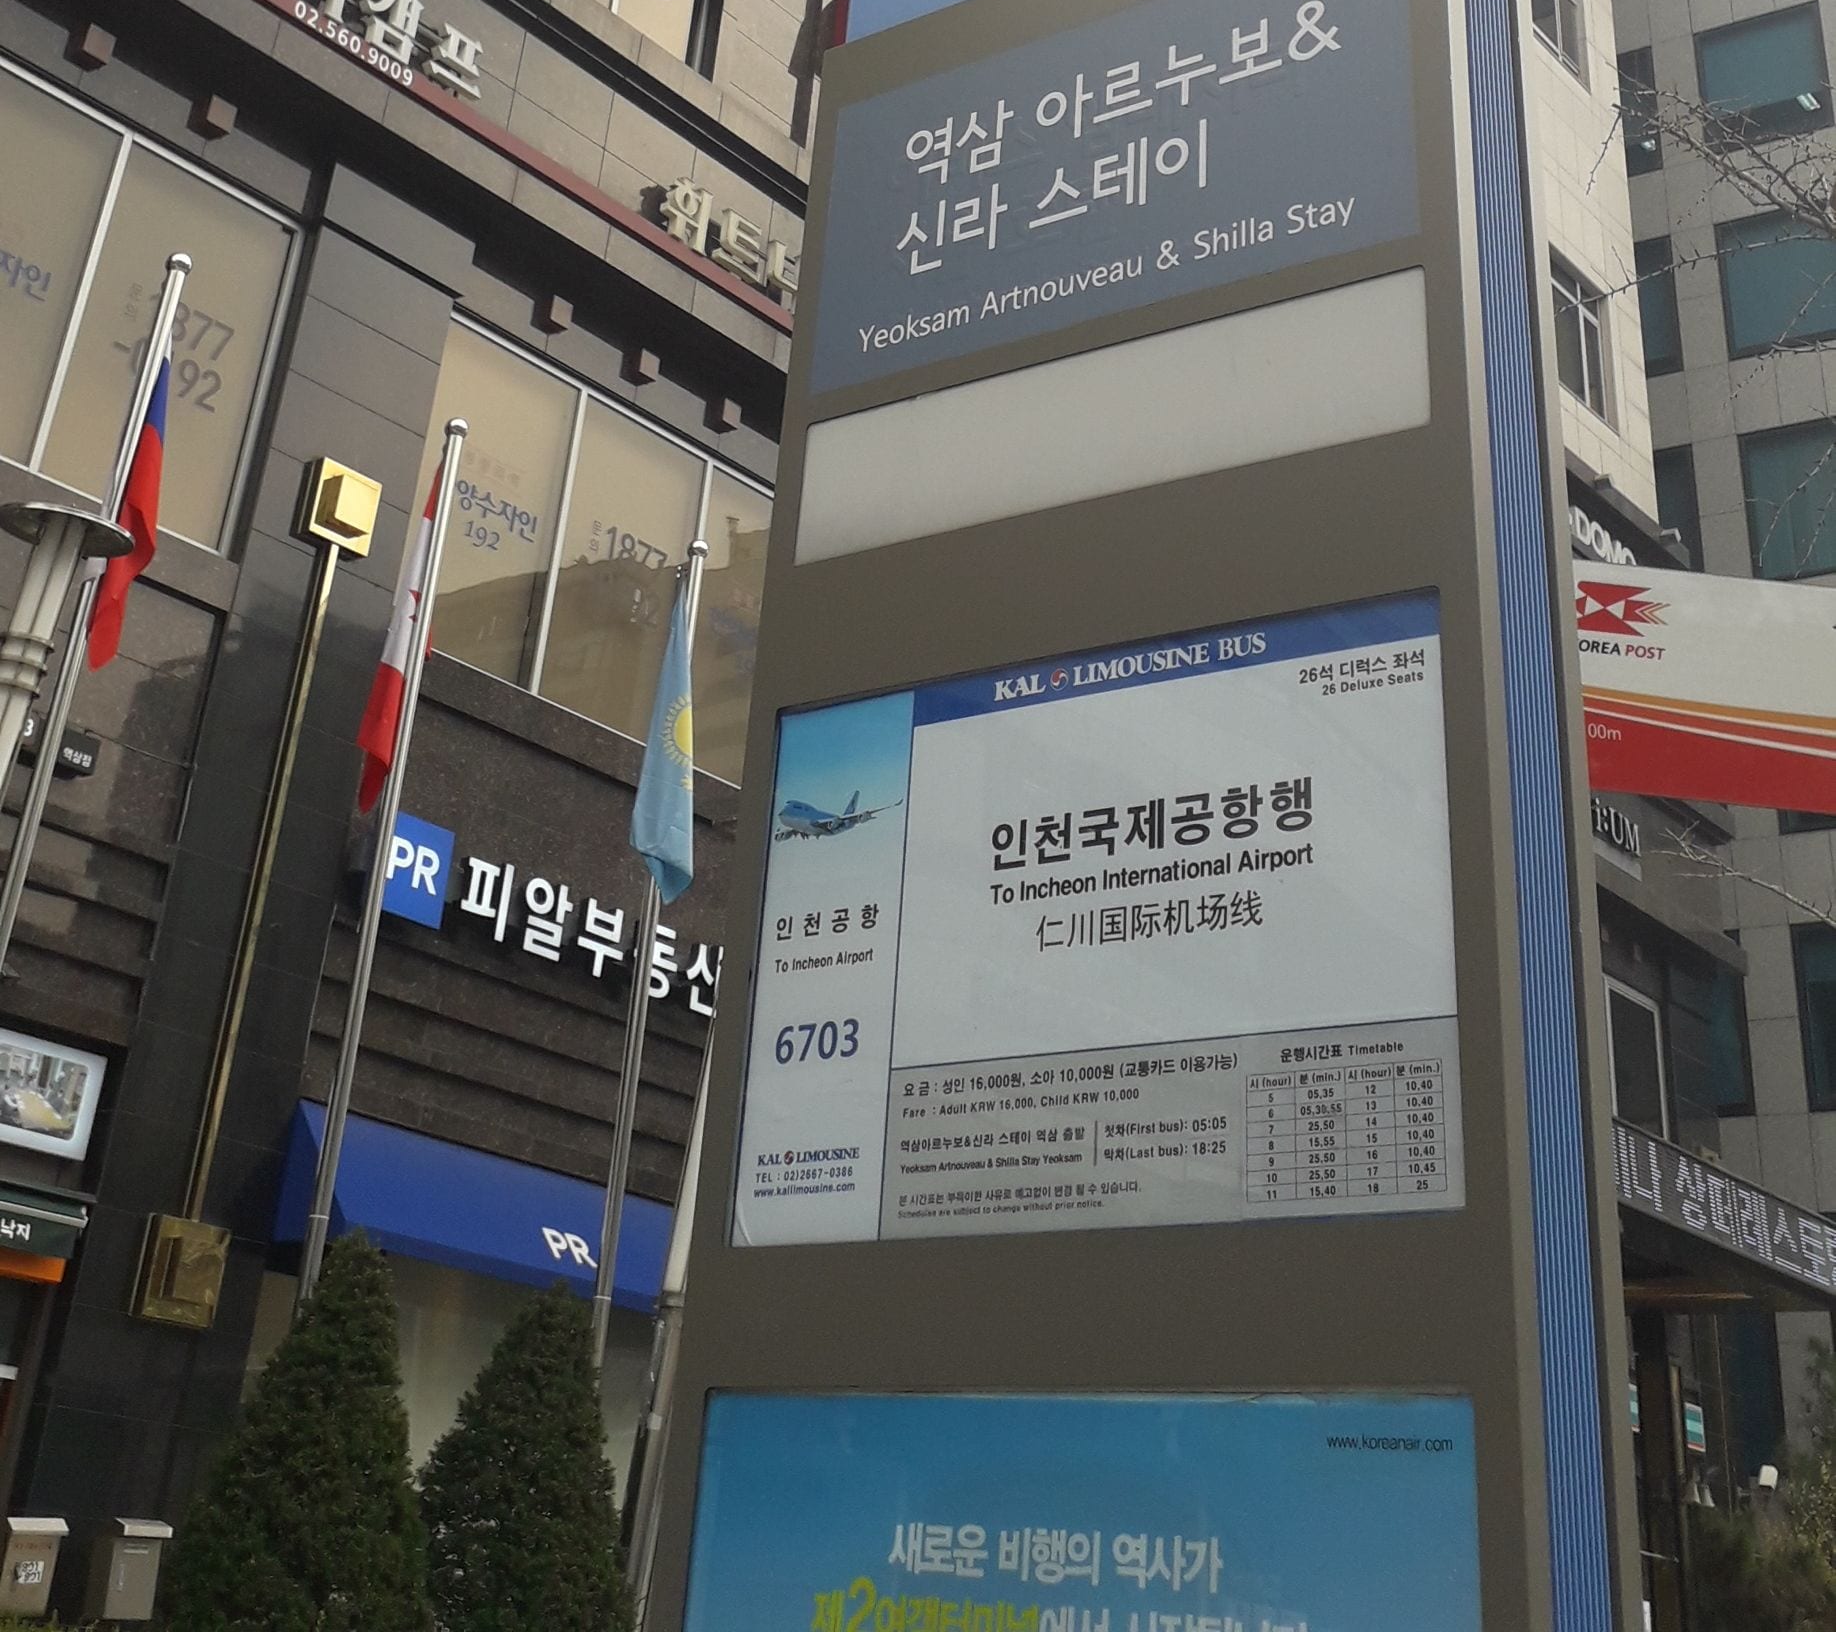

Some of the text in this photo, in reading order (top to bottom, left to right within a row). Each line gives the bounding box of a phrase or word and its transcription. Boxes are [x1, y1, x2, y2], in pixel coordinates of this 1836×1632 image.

[294, 1, 414, 86] 02.560.9009
[905, 100, 1014, 183] 역삼
[896, 119, 1207, 275] 신라 스테이
[859, 198, 1355, 352] Yeoksam Artnouveau & Shilla Stay
[1578, 639, 1666, 661] OREA POST
[994, 632, 1267, 701] KAL LIMOUSINE BUS
[1299, 649, 1424, 684] 26석 디럭스 좌석
[1322, 672, 1424, 696] 26 Deluxe Seats
[992, 777, 1312, 870] 인천국제공항행
[386, 835, 440, 896] PR
[991, 843, 1314, 905] To Incheon International Airport
[1036, 890, 1263, 952] 仁川国际机场线
[775, 948, 874, 973] To Incheon Airport
[775, 1018, 859, 1065] 6703
[1280, 1042, 1404, 1063] 운행시간표 Timetable
[943, 1077, 965, 1095] 성인
[1030, 1071, 1054, 1086] 소아
[1180, 1052, 1238, 1072] 이용가능)
[1365, 1084, 1377, 1095] 12
[902, 1107, 926, 1118] Fare
[939, 1103, 966, 1116] Adult
[1040, 1093, 1069, 1107] Child
[1073, 1091, 1099, 1104] KRW
[1104, 1088, 1139, 1103] 10,000
[1365, 1100, 1377, 1111] 13
[1192, 1116, 1227, 1132] 05:05
[1366, 1117, 1377, 1127] 14
[998, 1130, 1031, 1144] 스테이
[1036, 1128, 1057, 1142] 역삼
[1063, 1126, 1085, 1141] 출발
[1366, 1133, 1378, 1144] 15
[757, 1147, 860, 1166] KAL LIMOUSINE
[1192, 1140, 1227, 1156] 18:25
[1367, 1149, 1378, 1160] 16
[756, 1172, 773, 1183] TEL
[1367, 1166, 1379, 1176] 17
[1368, 1183, 1379, 1193] 18
[1416, 1179, 1429, 1190] 25
[542, 1227, 598, 1268] PR
[1326, 1433, 1453, 1452] www.koreanair.com
[889, 1521, 1223, 1594] 새로운 비행의 역사가
